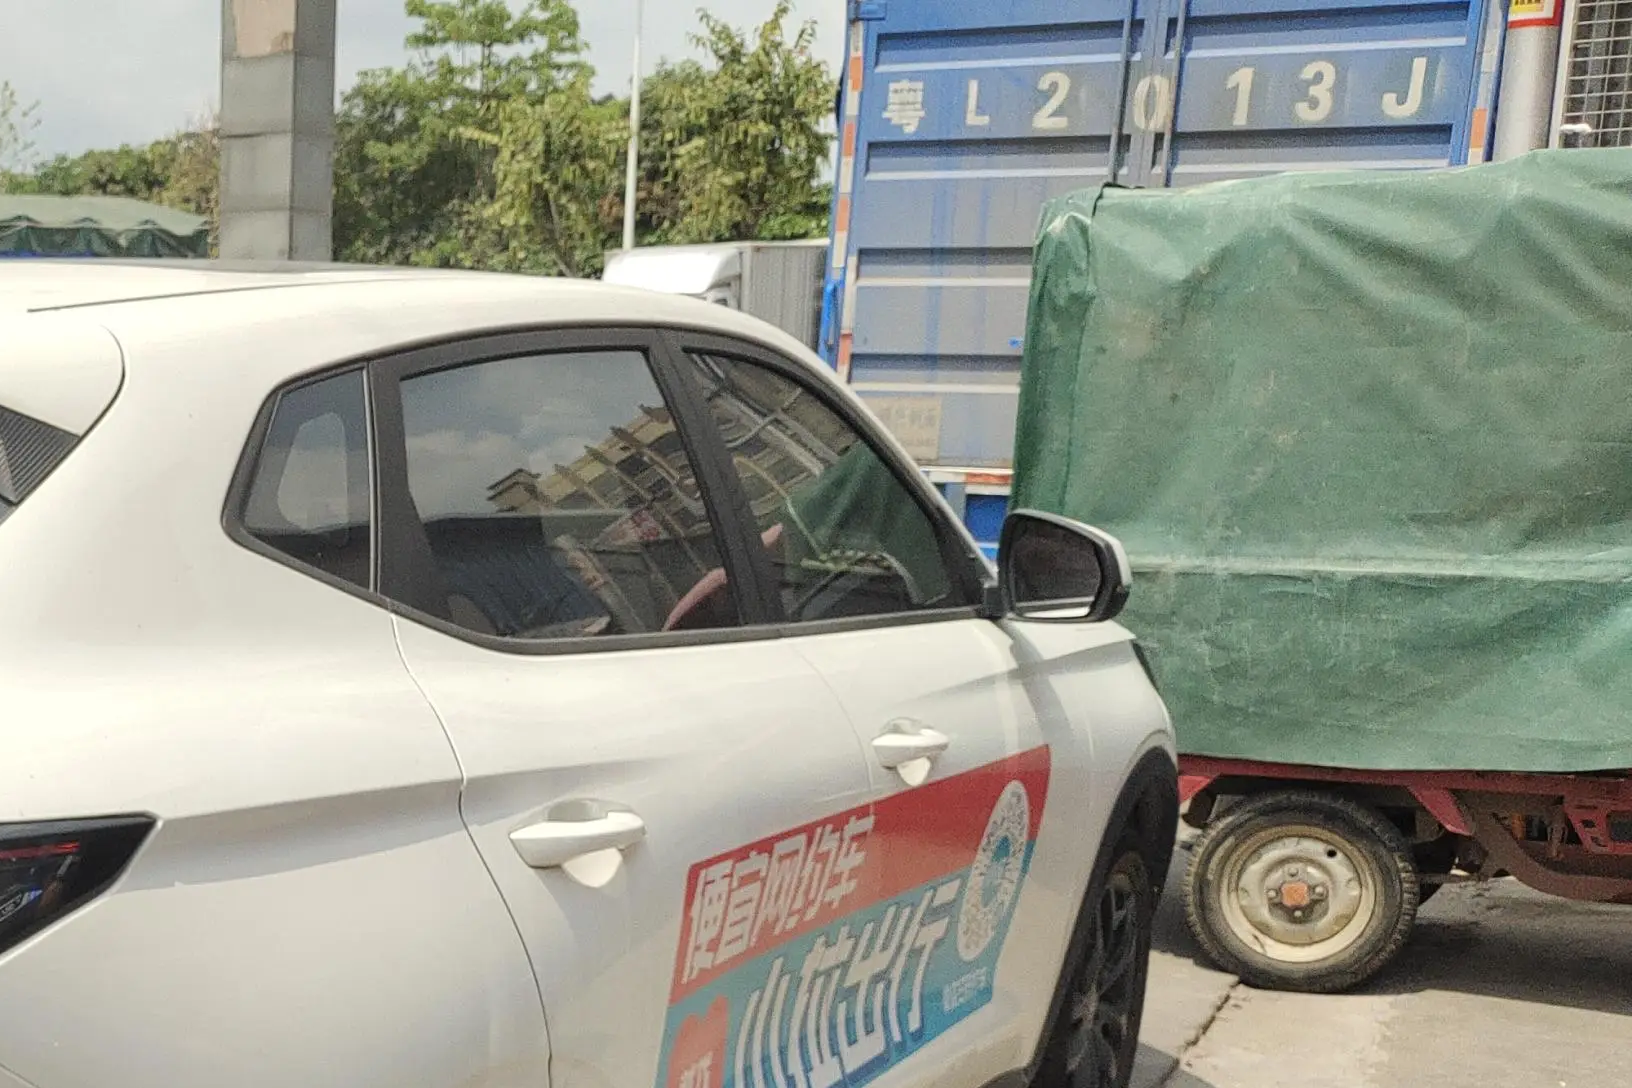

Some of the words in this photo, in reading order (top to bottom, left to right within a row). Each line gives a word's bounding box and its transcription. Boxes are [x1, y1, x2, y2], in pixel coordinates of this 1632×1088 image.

[881, 56, 1428, 134] 粤L2013J
[680, 813, 876, 985] 便宜网约车
